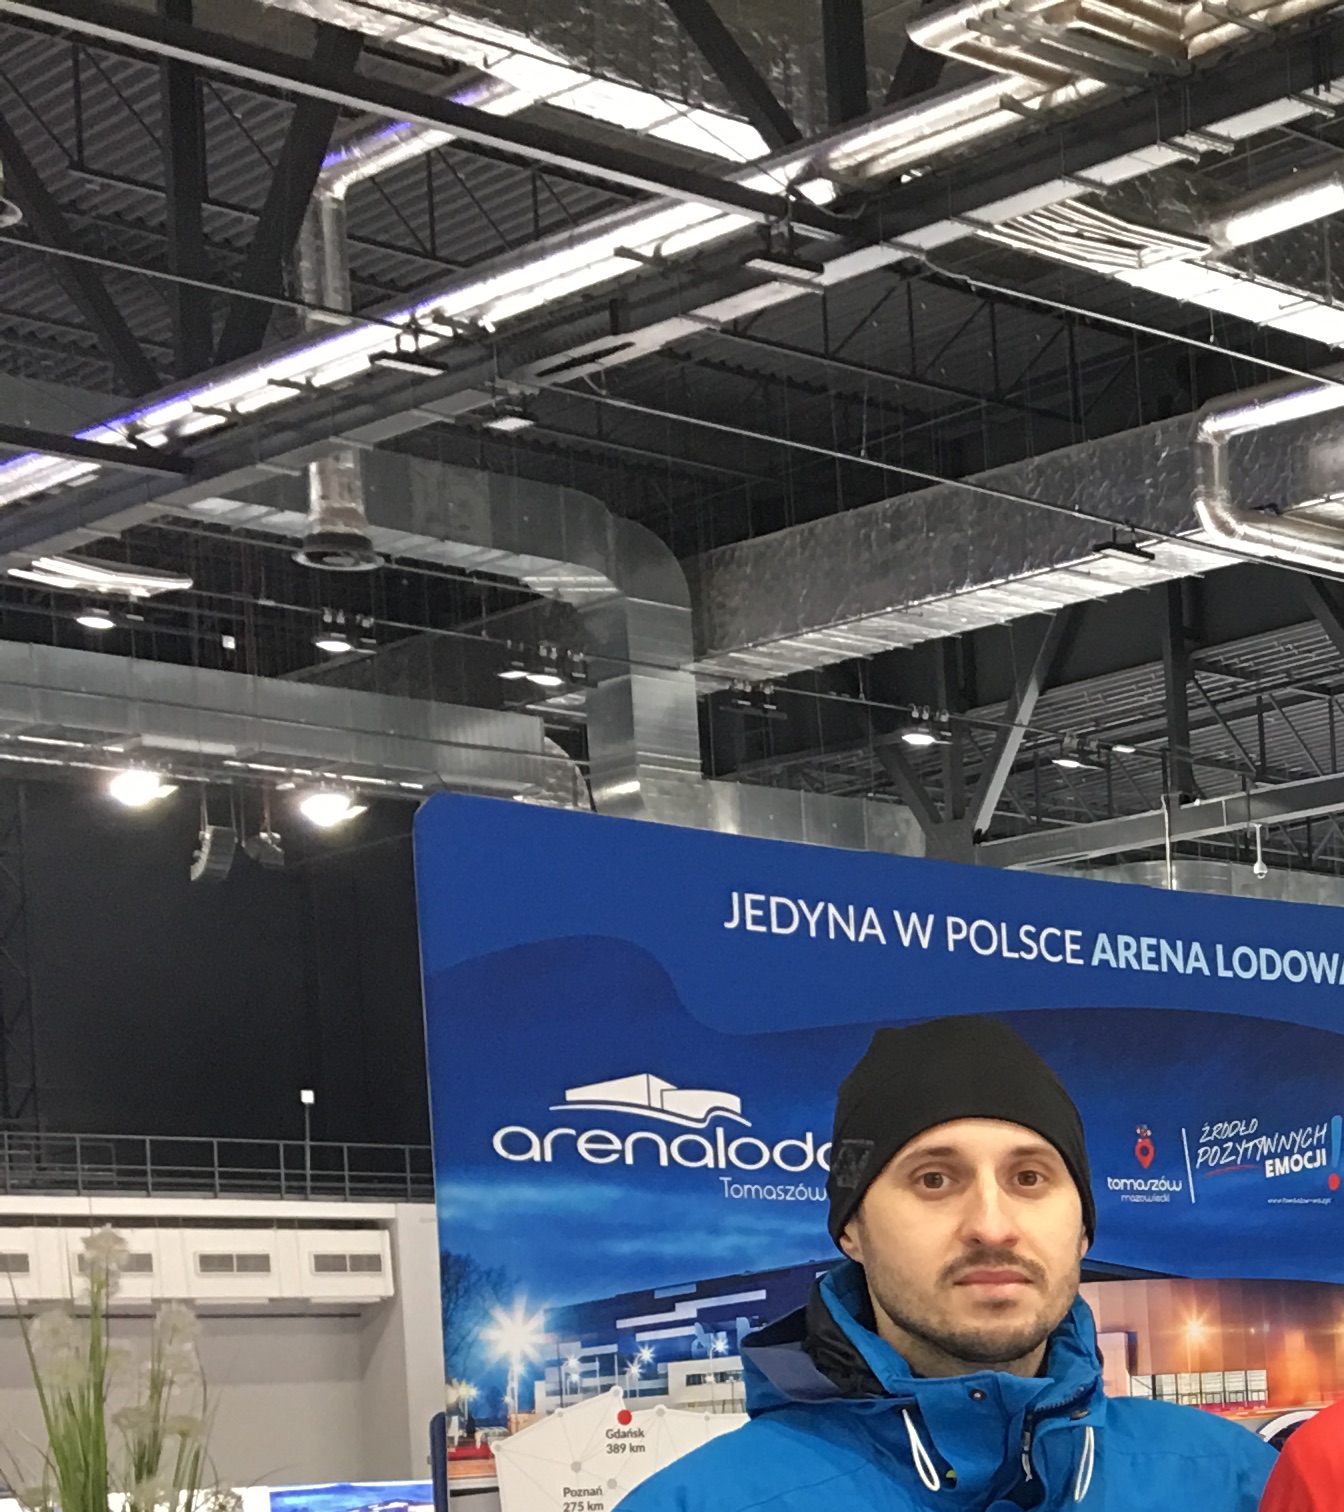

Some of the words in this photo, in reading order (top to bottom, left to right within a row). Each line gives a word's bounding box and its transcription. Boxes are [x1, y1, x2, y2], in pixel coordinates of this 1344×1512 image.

[723, 891, 887, 945] JEDYNA
[893, 910, 935, 949] W
[946, 916, 1085, 965] POLSCE
[1091, 932, 1211, 976] ARENA
[1106, 1175, 1183, 1192] tomaszów
[605, 1428, 646, 1440] Gdańsk
[606, 1443, 627, 1454] 389
[629, 1442, 646, 1453] km
[563, 1487, 603, 1498] Poznań
[563, 1502, 585, 1512] 275
[587, 1501, 604, 1511] km
